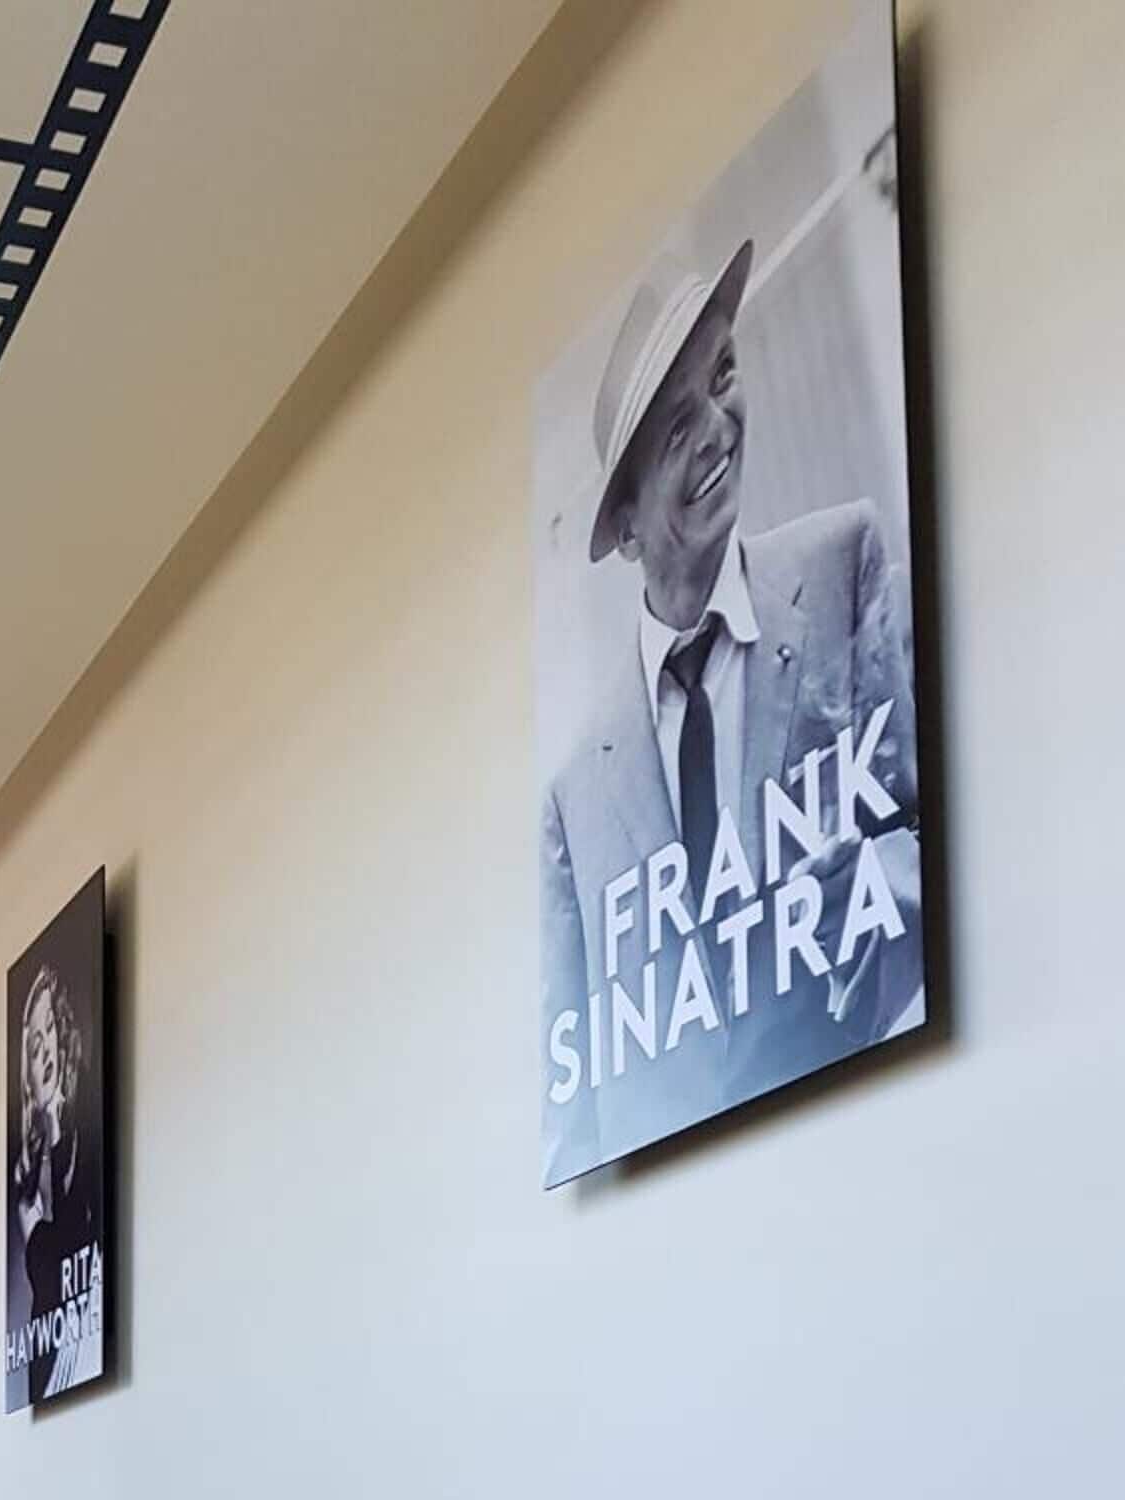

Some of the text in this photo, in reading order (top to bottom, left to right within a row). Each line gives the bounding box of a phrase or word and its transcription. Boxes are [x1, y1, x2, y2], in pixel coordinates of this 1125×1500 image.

[605, 699, 900, 978] FRANK
[547, 836, 907, 1105] SINATRA
[6, 1285, 103, 1376] HAYWORTH
[62, 1239, 102, 1302] RITA
